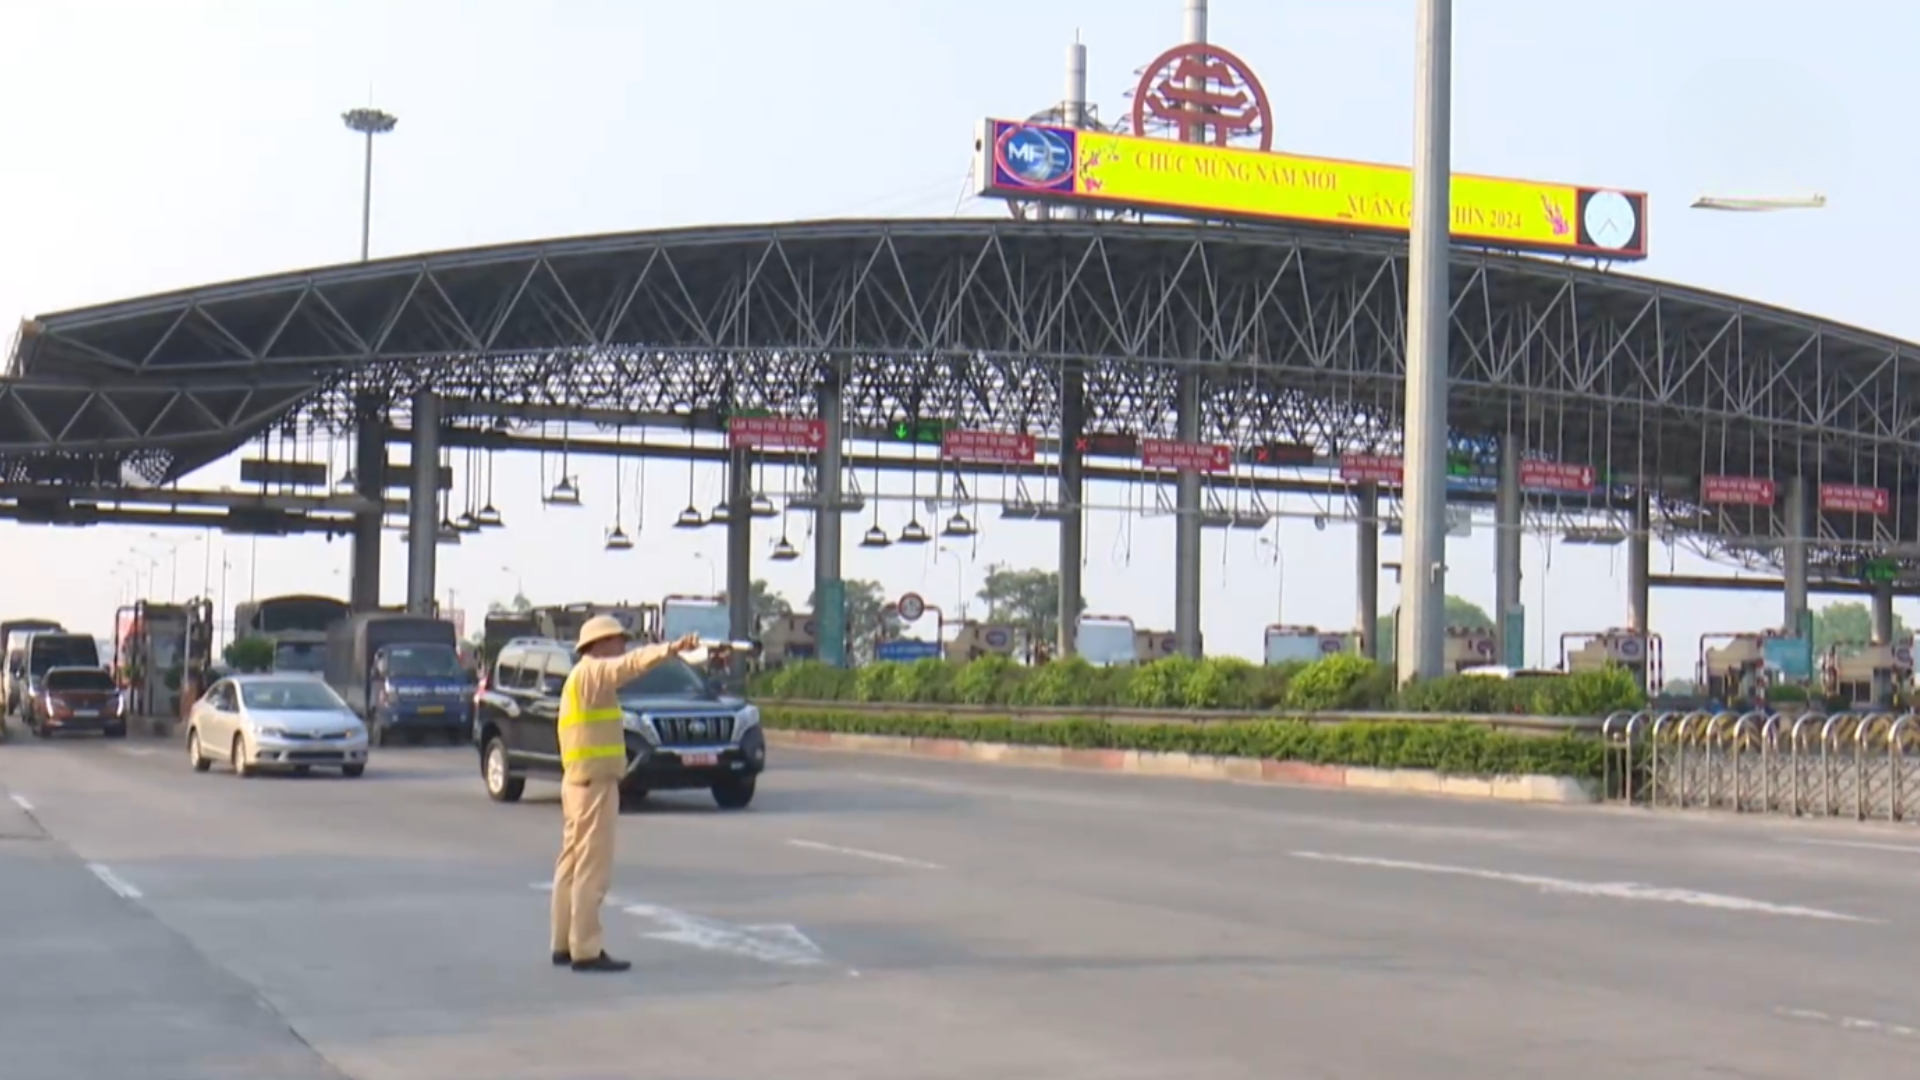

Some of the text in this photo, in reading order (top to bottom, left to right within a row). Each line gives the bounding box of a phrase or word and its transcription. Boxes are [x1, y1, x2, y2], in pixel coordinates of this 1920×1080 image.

[1135, 147, 1186, 174] CHÚC
[1195, 153, 1251, 182] MỪNG
[1489, 208, 1523, 230] 2024
